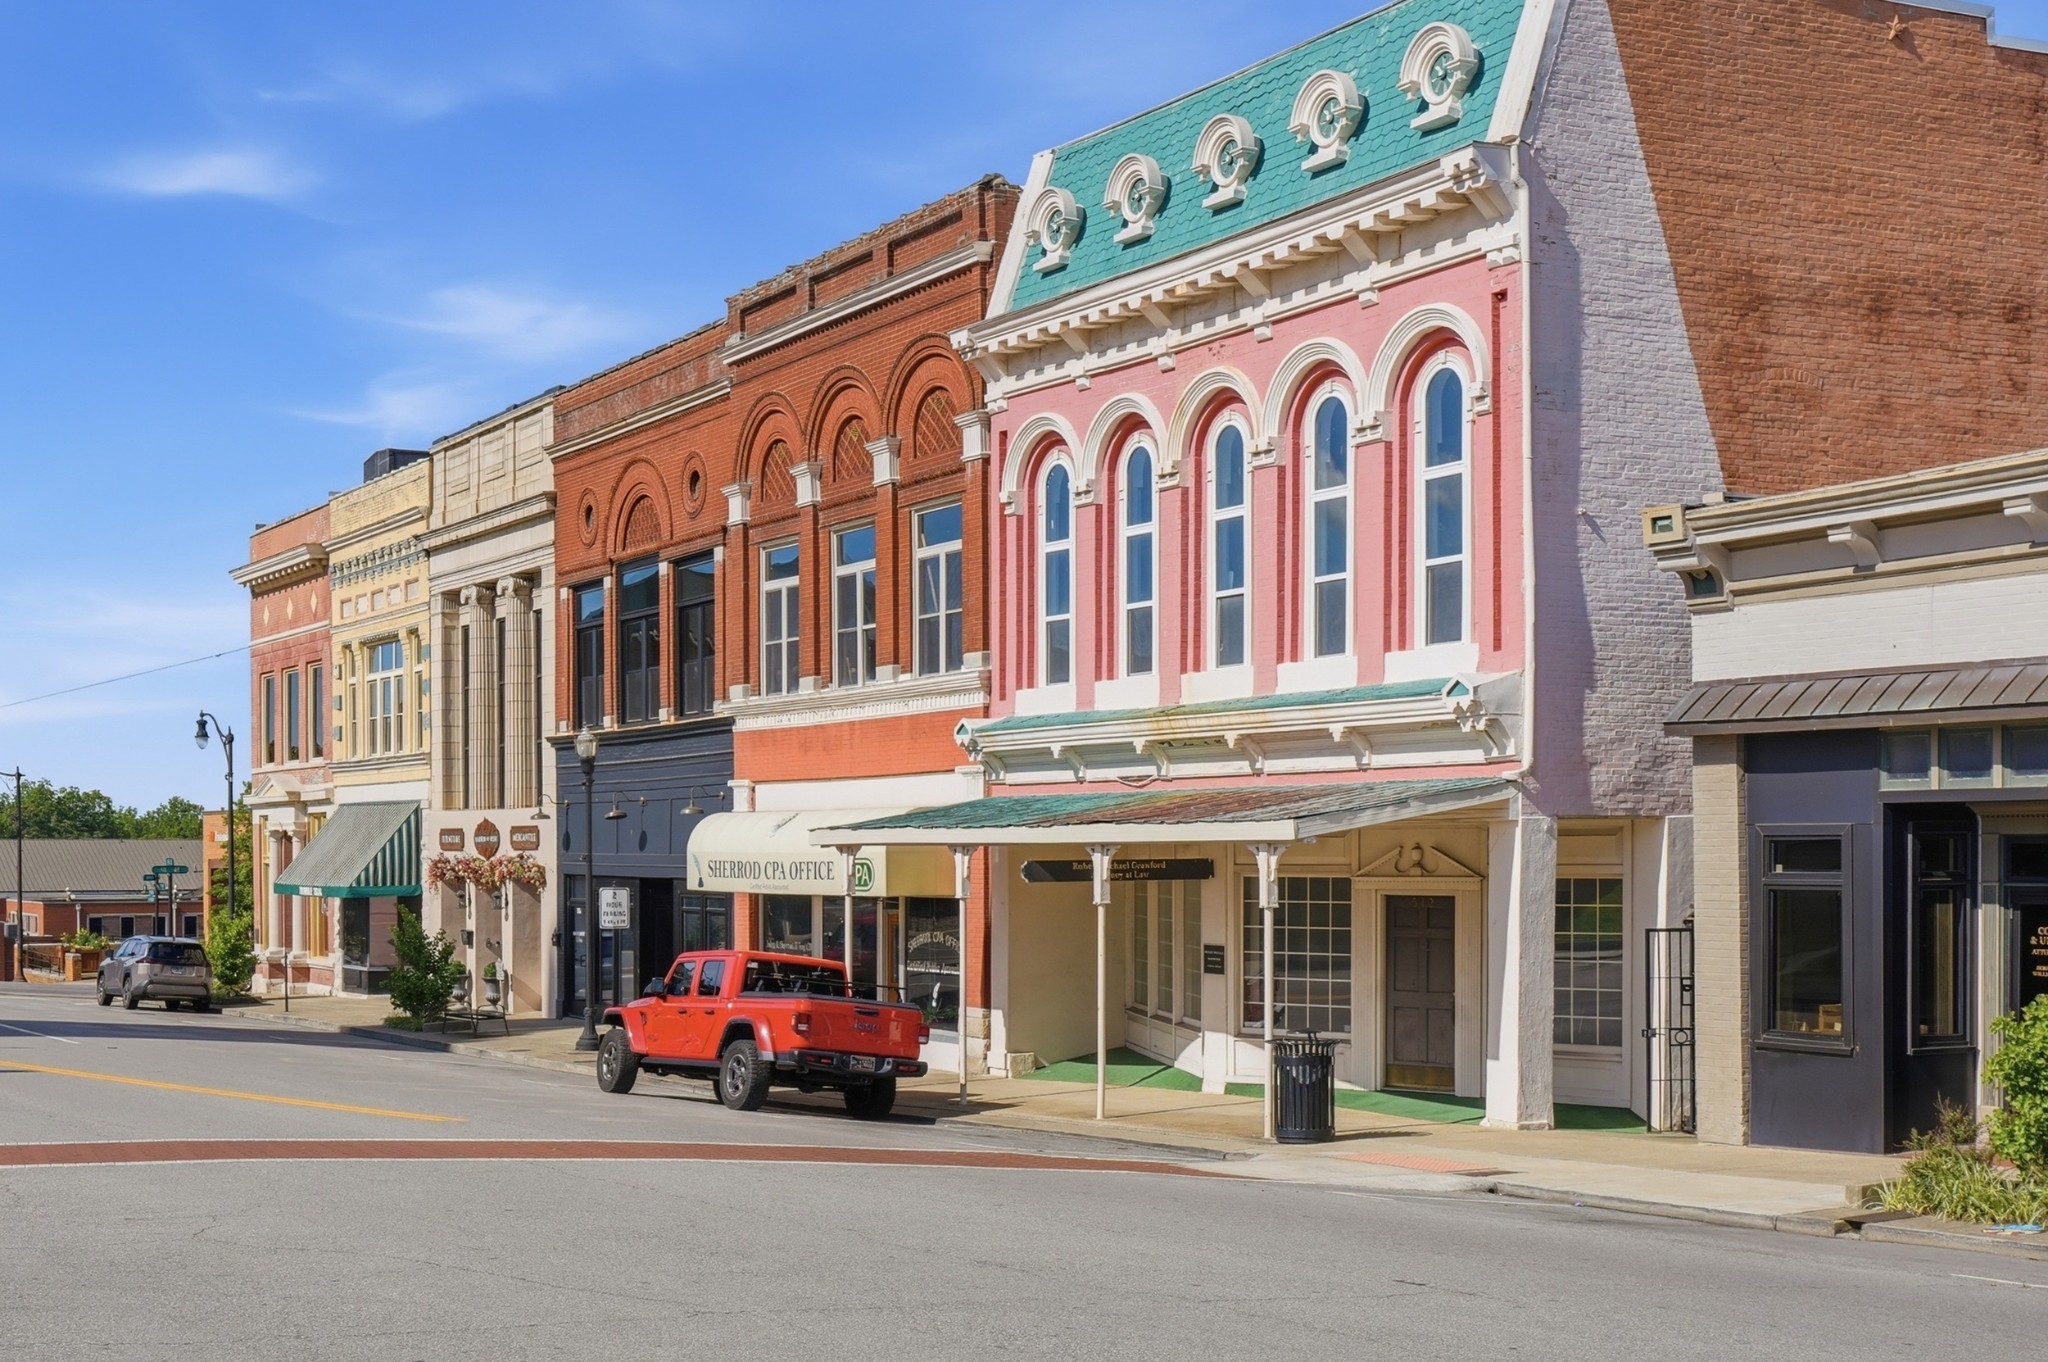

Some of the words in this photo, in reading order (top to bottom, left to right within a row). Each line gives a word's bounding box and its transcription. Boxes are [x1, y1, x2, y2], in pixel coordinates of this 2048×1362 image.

[707, 859, 761, 880] SHERROD
[764, 860, 786, 880] CPA
[789, 860, 835, 881] OFFICE
[855, 867, 870, 885] PA
[612, 891, 617, 900] 2
[2030, 935, 2038, 945] &
[2039, 936, 2048, 945] U
